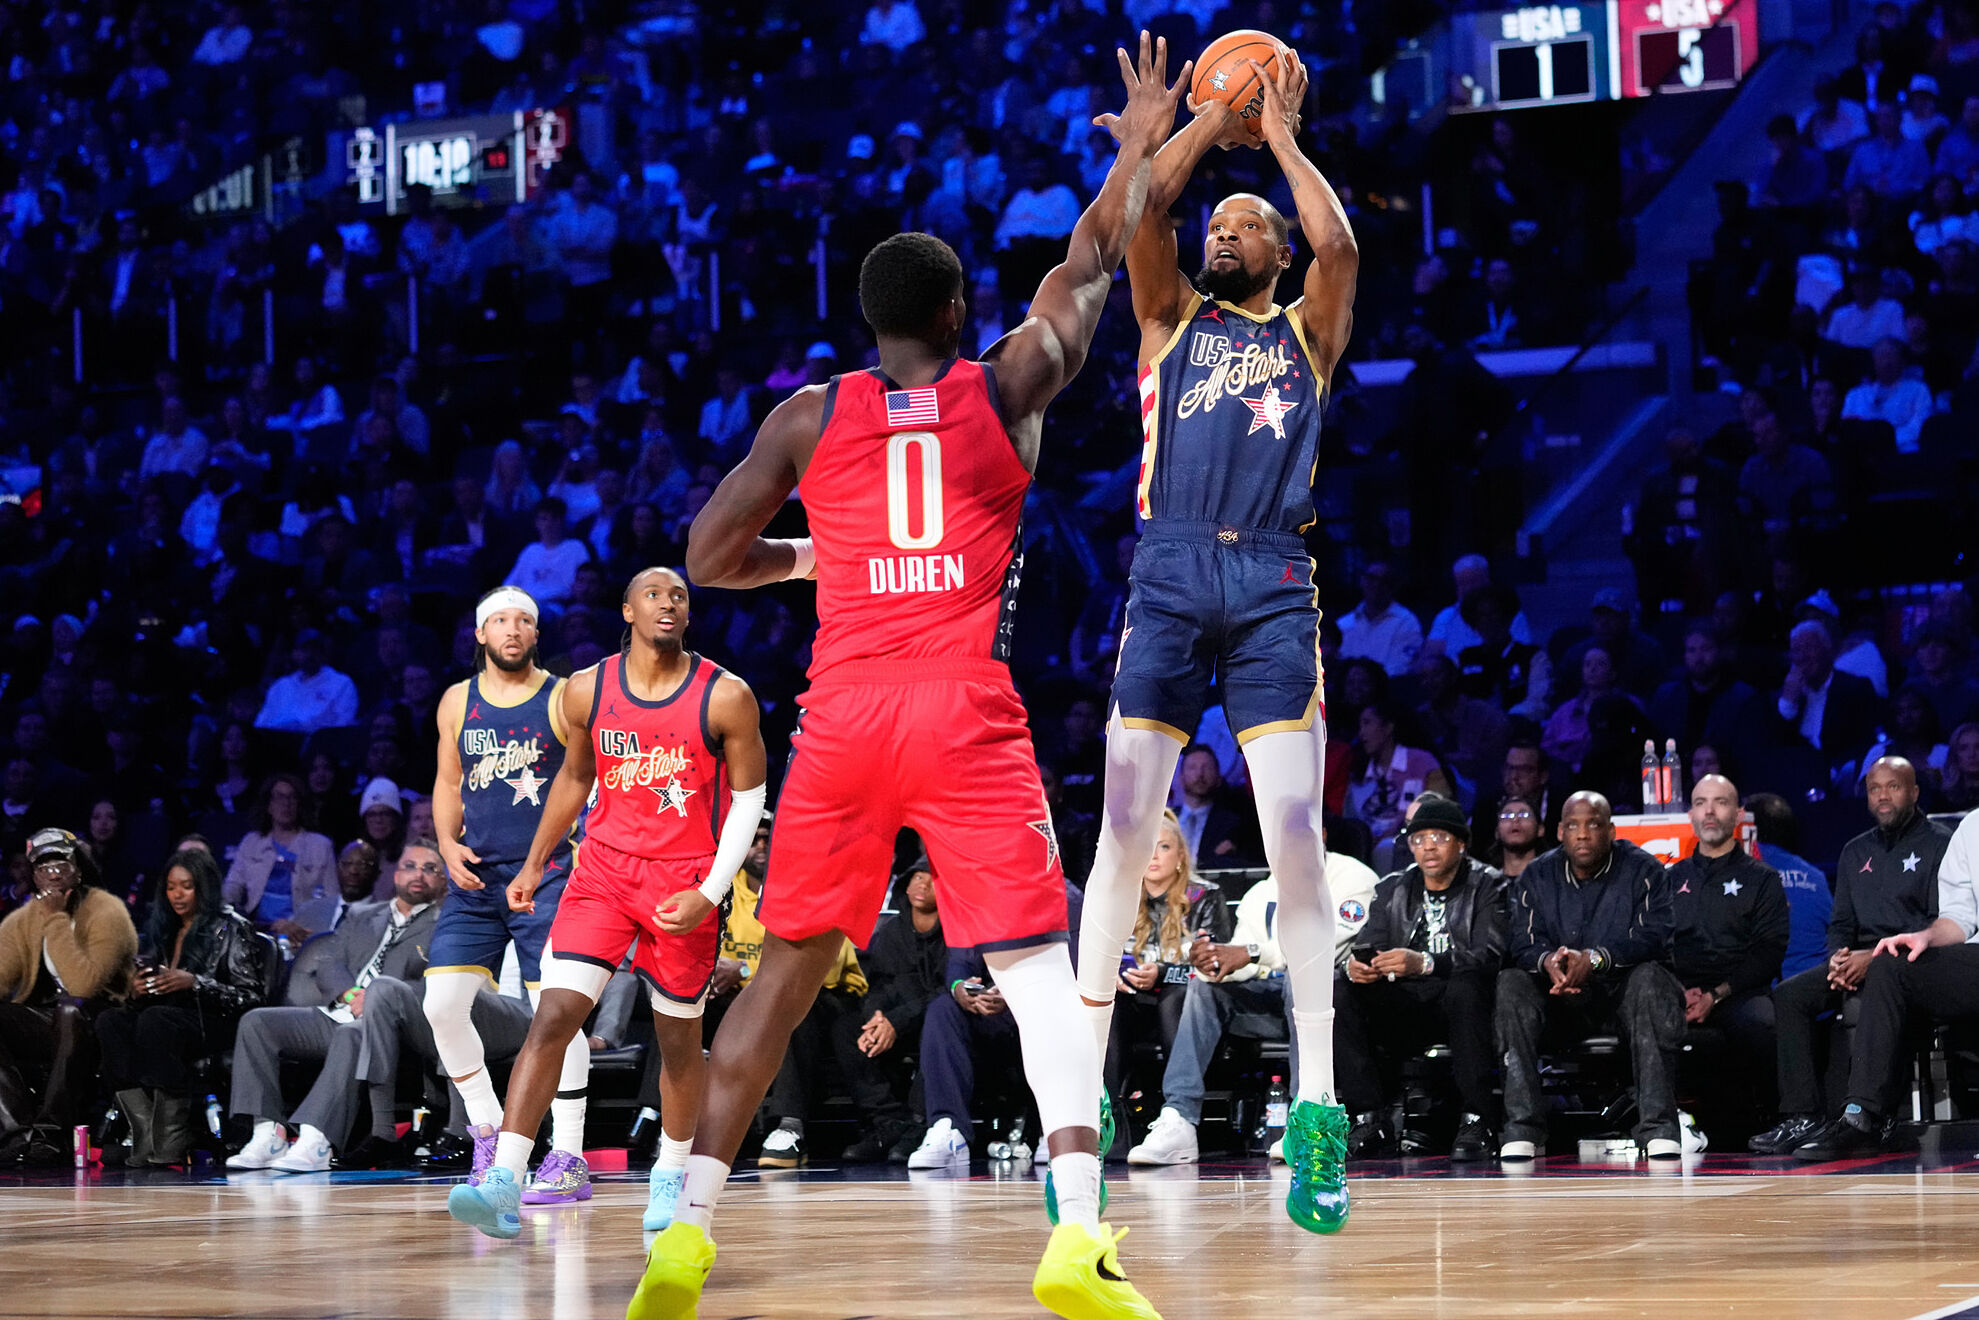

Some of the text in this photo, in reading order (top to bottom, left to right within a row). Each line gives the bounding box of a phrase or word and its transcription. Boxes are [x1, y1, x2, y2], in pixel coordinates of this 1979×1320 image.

[1517, 6, 1566, 42] USA
[1535, 42, 1554, 100] 1
[1678, 28, 1704, 87] 5
[887, 431, 943, 549] 0
[868, 554, 965, 594] DUREN
[464, 728, 500, 756] USA
[599, 728, 642, 760] USA
